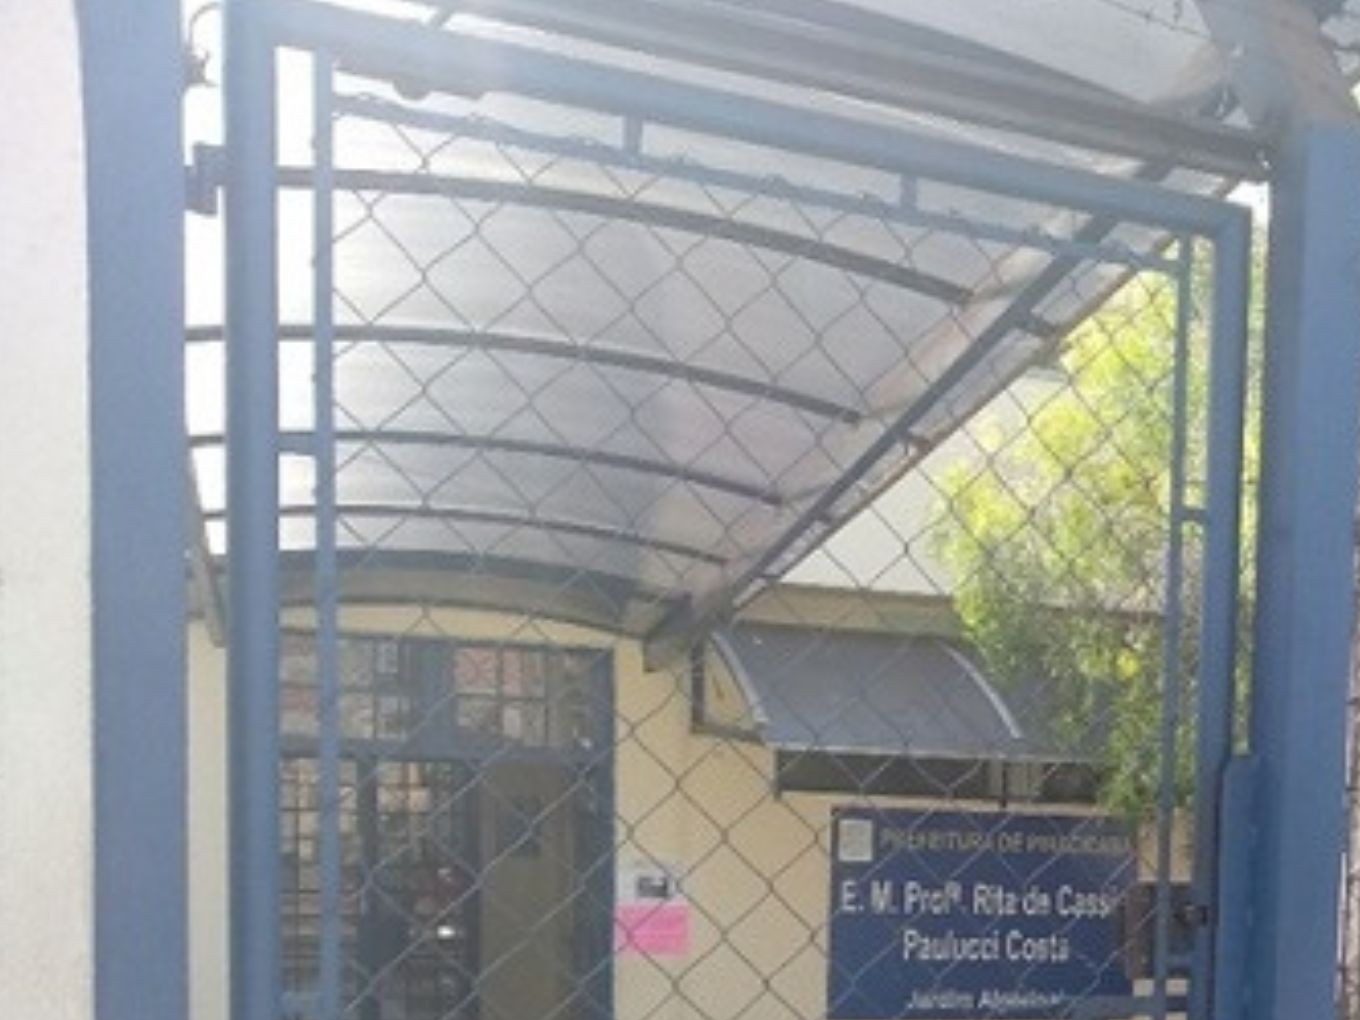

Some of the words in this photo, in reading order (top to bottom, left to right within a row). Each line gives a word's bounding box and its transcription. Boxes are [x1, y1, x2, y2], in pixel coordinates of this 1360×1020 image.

[999, 832, 1025, 854] DE
[841, 880, 864, 912] E.
[871, 881, 899, 914] M.
[973, 883, 1017, 915] Rita
[1023, 884, 1050, 915] de
[903, 929, 1000, 960] Paulucci
[1005, 930, 1070, 961] Costa
